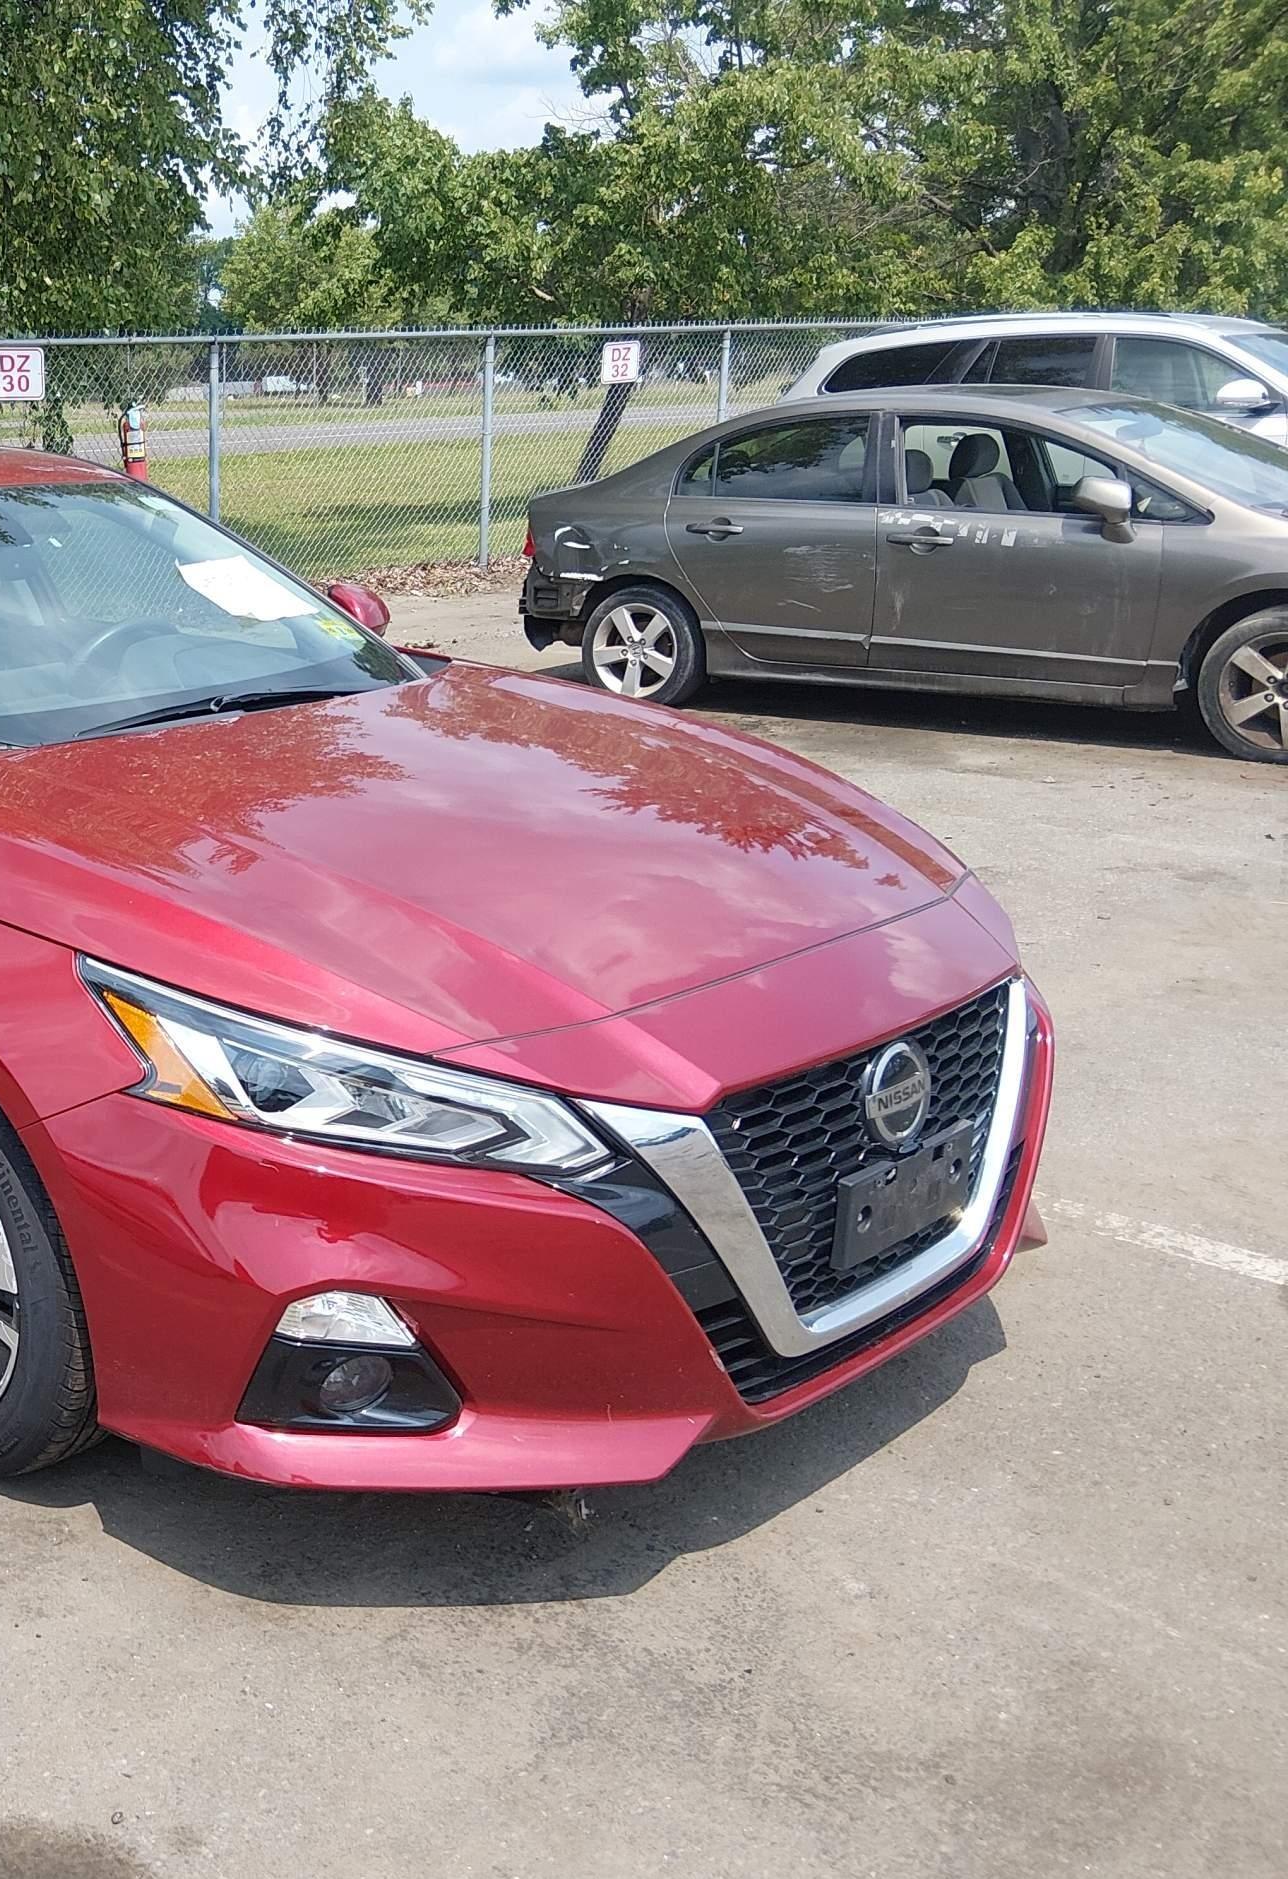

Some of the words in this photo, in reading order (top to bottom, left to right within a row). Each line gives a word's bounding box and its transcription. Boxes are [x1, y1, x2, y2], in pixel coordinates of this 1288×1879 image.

[0, 354, 30, 372] DZ
[611, 347, 631, 362] DZ
[611, 363, 629, 378] 32
[2, 375, 30, 393] 30
[877, 1078, 926, 1112] NISSAN
